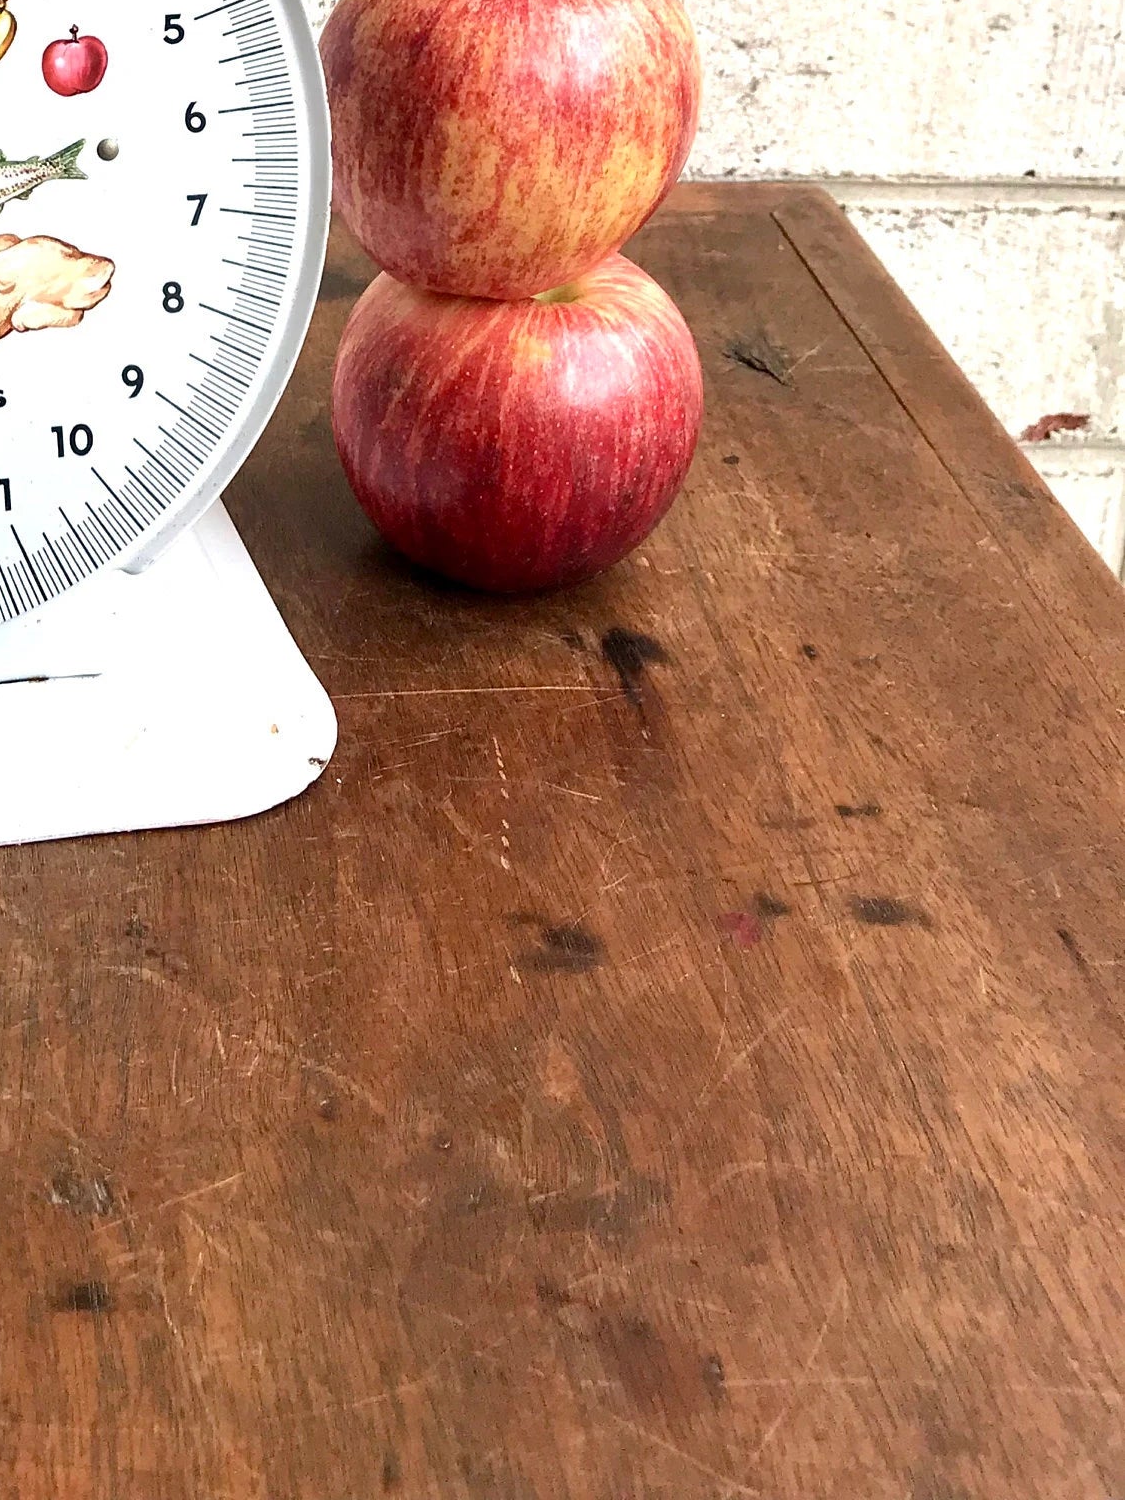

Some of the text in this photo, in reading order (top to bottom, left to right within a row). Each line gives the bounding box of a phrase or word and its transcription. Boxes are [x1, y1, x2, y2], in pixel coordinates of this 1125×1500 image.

[163, 13, 185, 45] 5
[184, 101, 207, 134] 6
[186, 193, 208, 227] 7
[162, 281, 185, 314] 8
[121, 364, 145, 399] 9
[50, 423, 94, 458] 10
